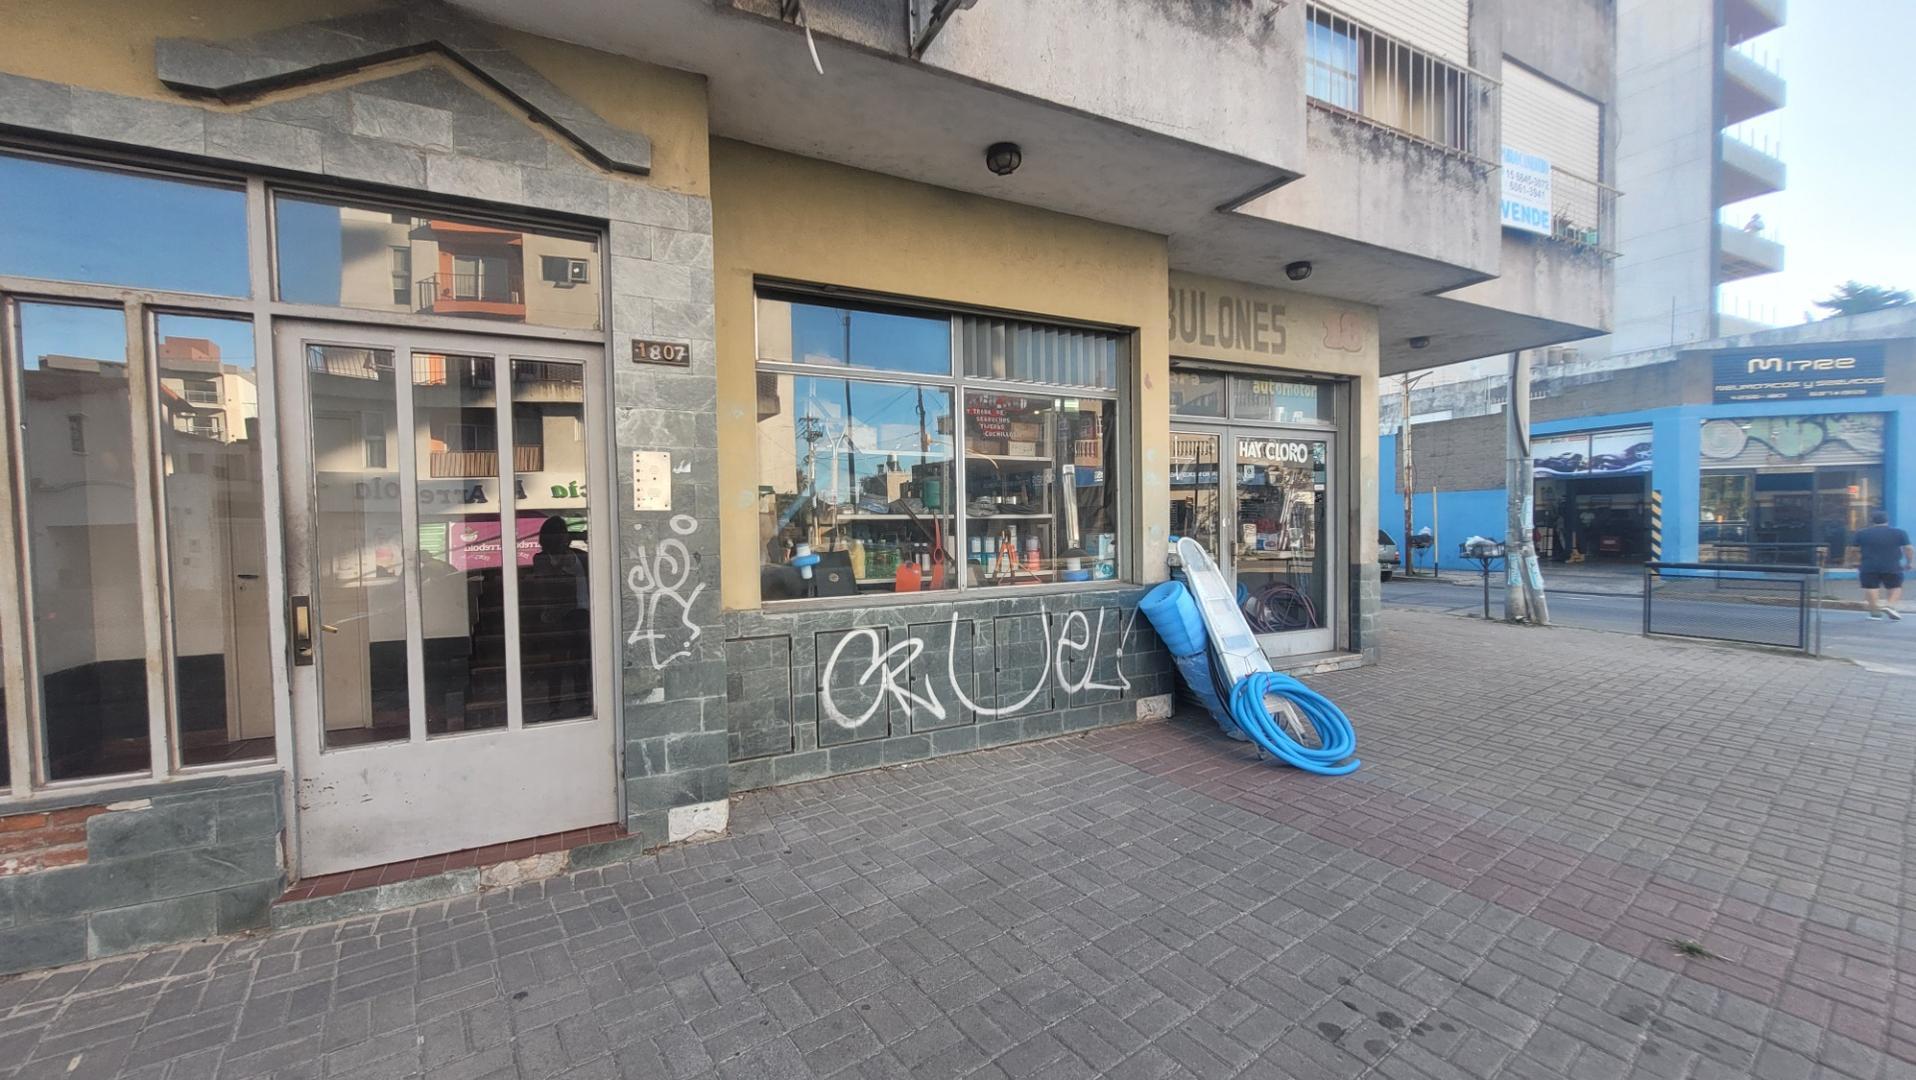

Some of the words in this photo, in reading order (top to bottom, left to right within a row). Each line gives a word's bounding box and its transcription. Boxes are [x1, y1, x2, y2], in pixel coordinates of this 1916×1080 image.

[1500, 200, 1550, 228] VENDE
[637, 342, 687, 362] 1807
[1239, 441, 1263, 458] HAY
[1265, 442, 1308, 464] CLORO
